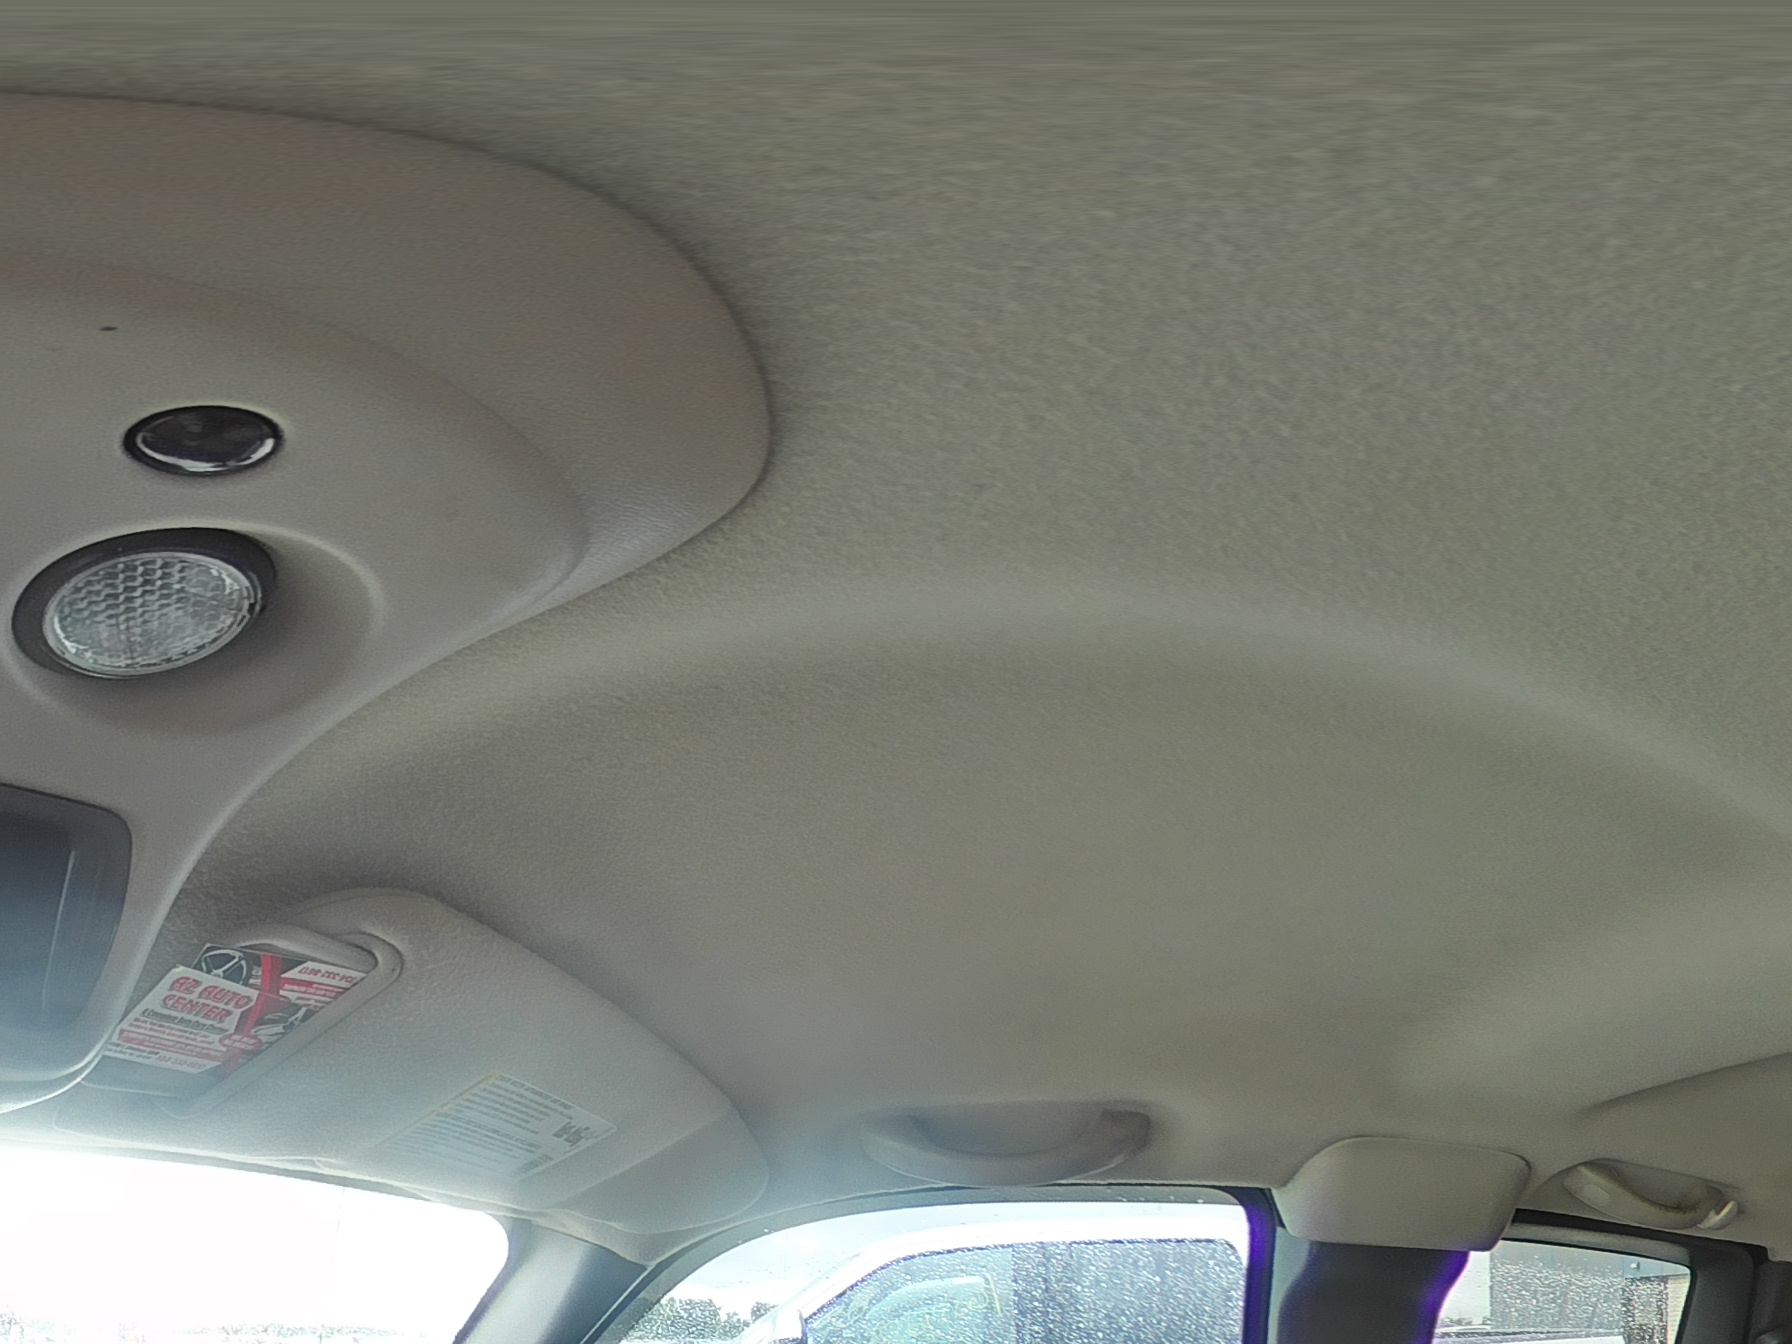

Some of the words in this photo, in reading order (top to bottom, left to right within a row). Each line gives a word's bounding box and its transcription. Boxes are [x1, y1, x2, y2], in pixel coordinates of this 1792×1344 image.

[168, 976, 202, 994] AZ
[198, 986, 255, 1009] AUTO
[161, 994, 233, 1023] CENTER
